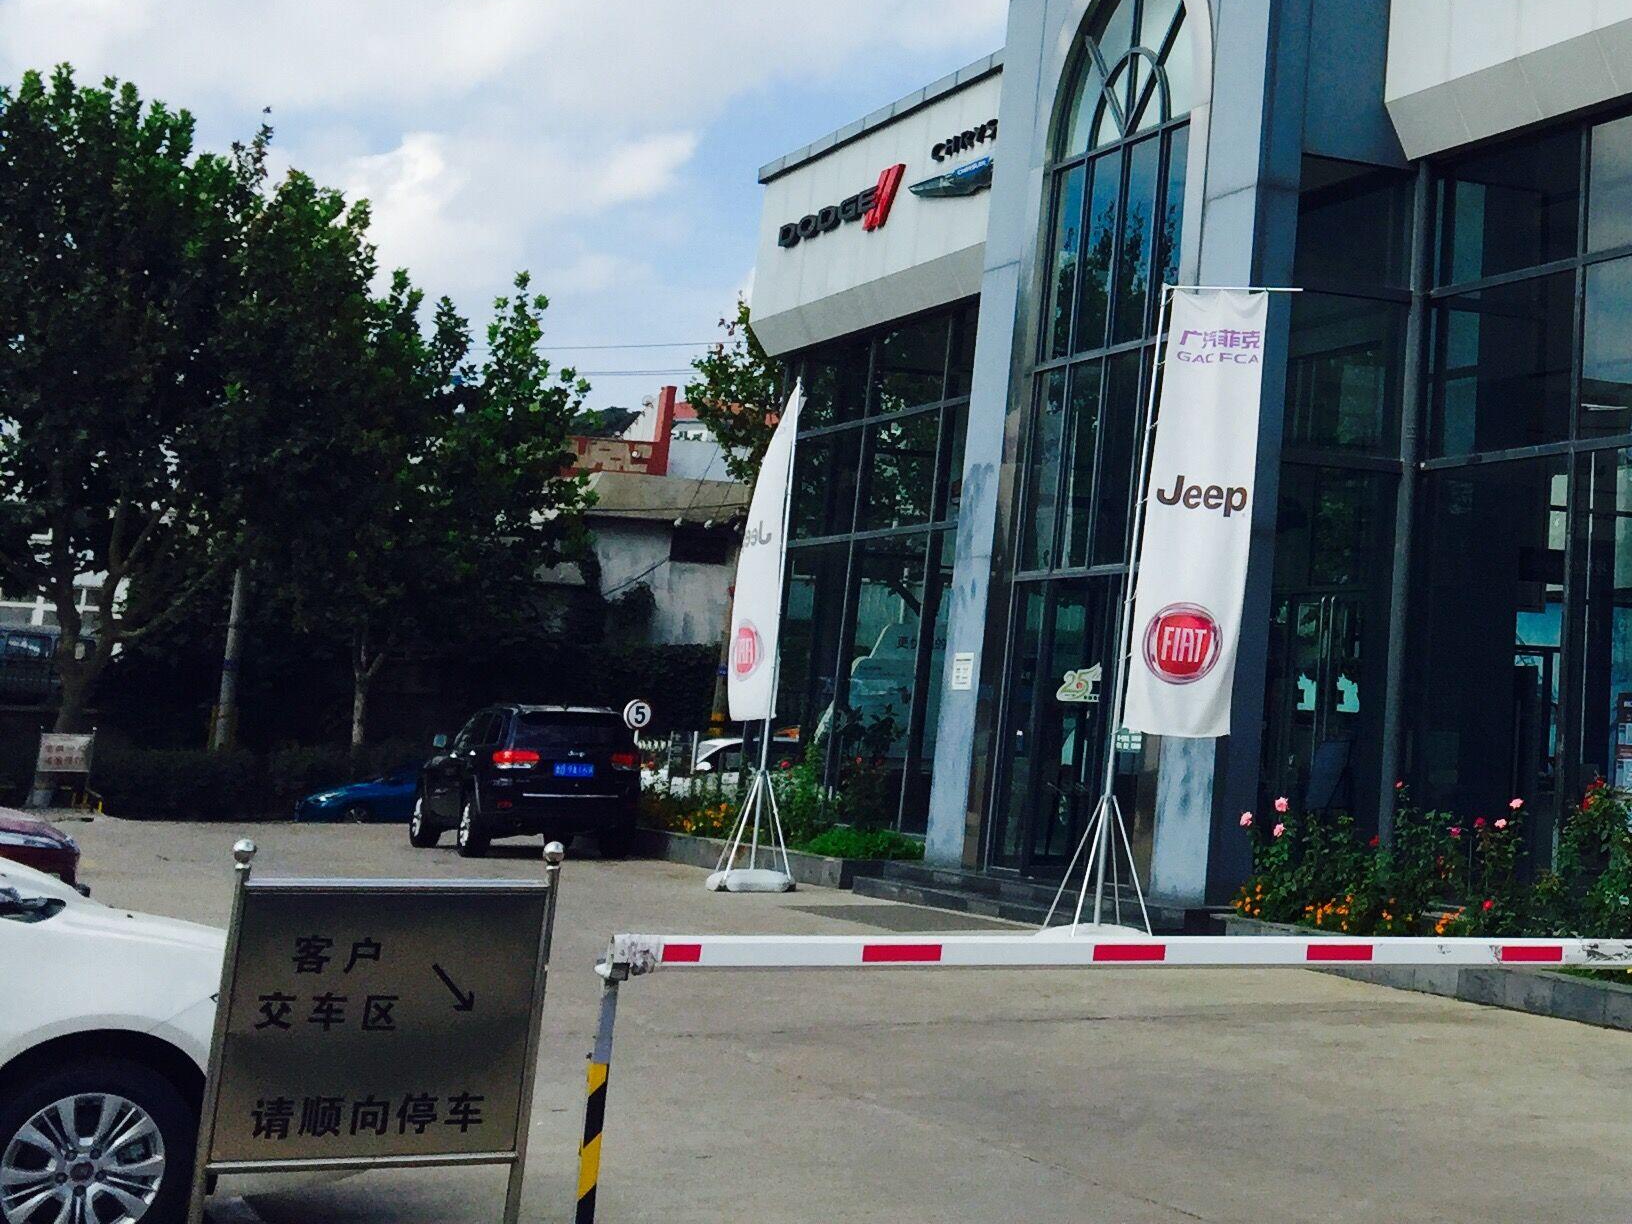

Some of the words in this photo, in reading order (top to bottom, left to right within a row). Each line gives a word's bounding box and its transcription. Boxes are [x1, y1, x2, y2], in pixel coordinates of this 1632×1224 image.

[778, 185, 879, 248] DODGE
[1177, 351, 1214, 364] GAC
[1219, 352, 1259, 364] FCA
[1180, 329, 1260, 349] 广汽菲克
[1157, 475, 1248, 517] Jeep
[1161, 626, 1210, 663] FIAT
[634, 706, 646, 724] 5
[292, 935, 382, 974] 客户
[255, 991, 399, 1031] 交车区
[251, 1092, 485, 1140] 请顺向停车
